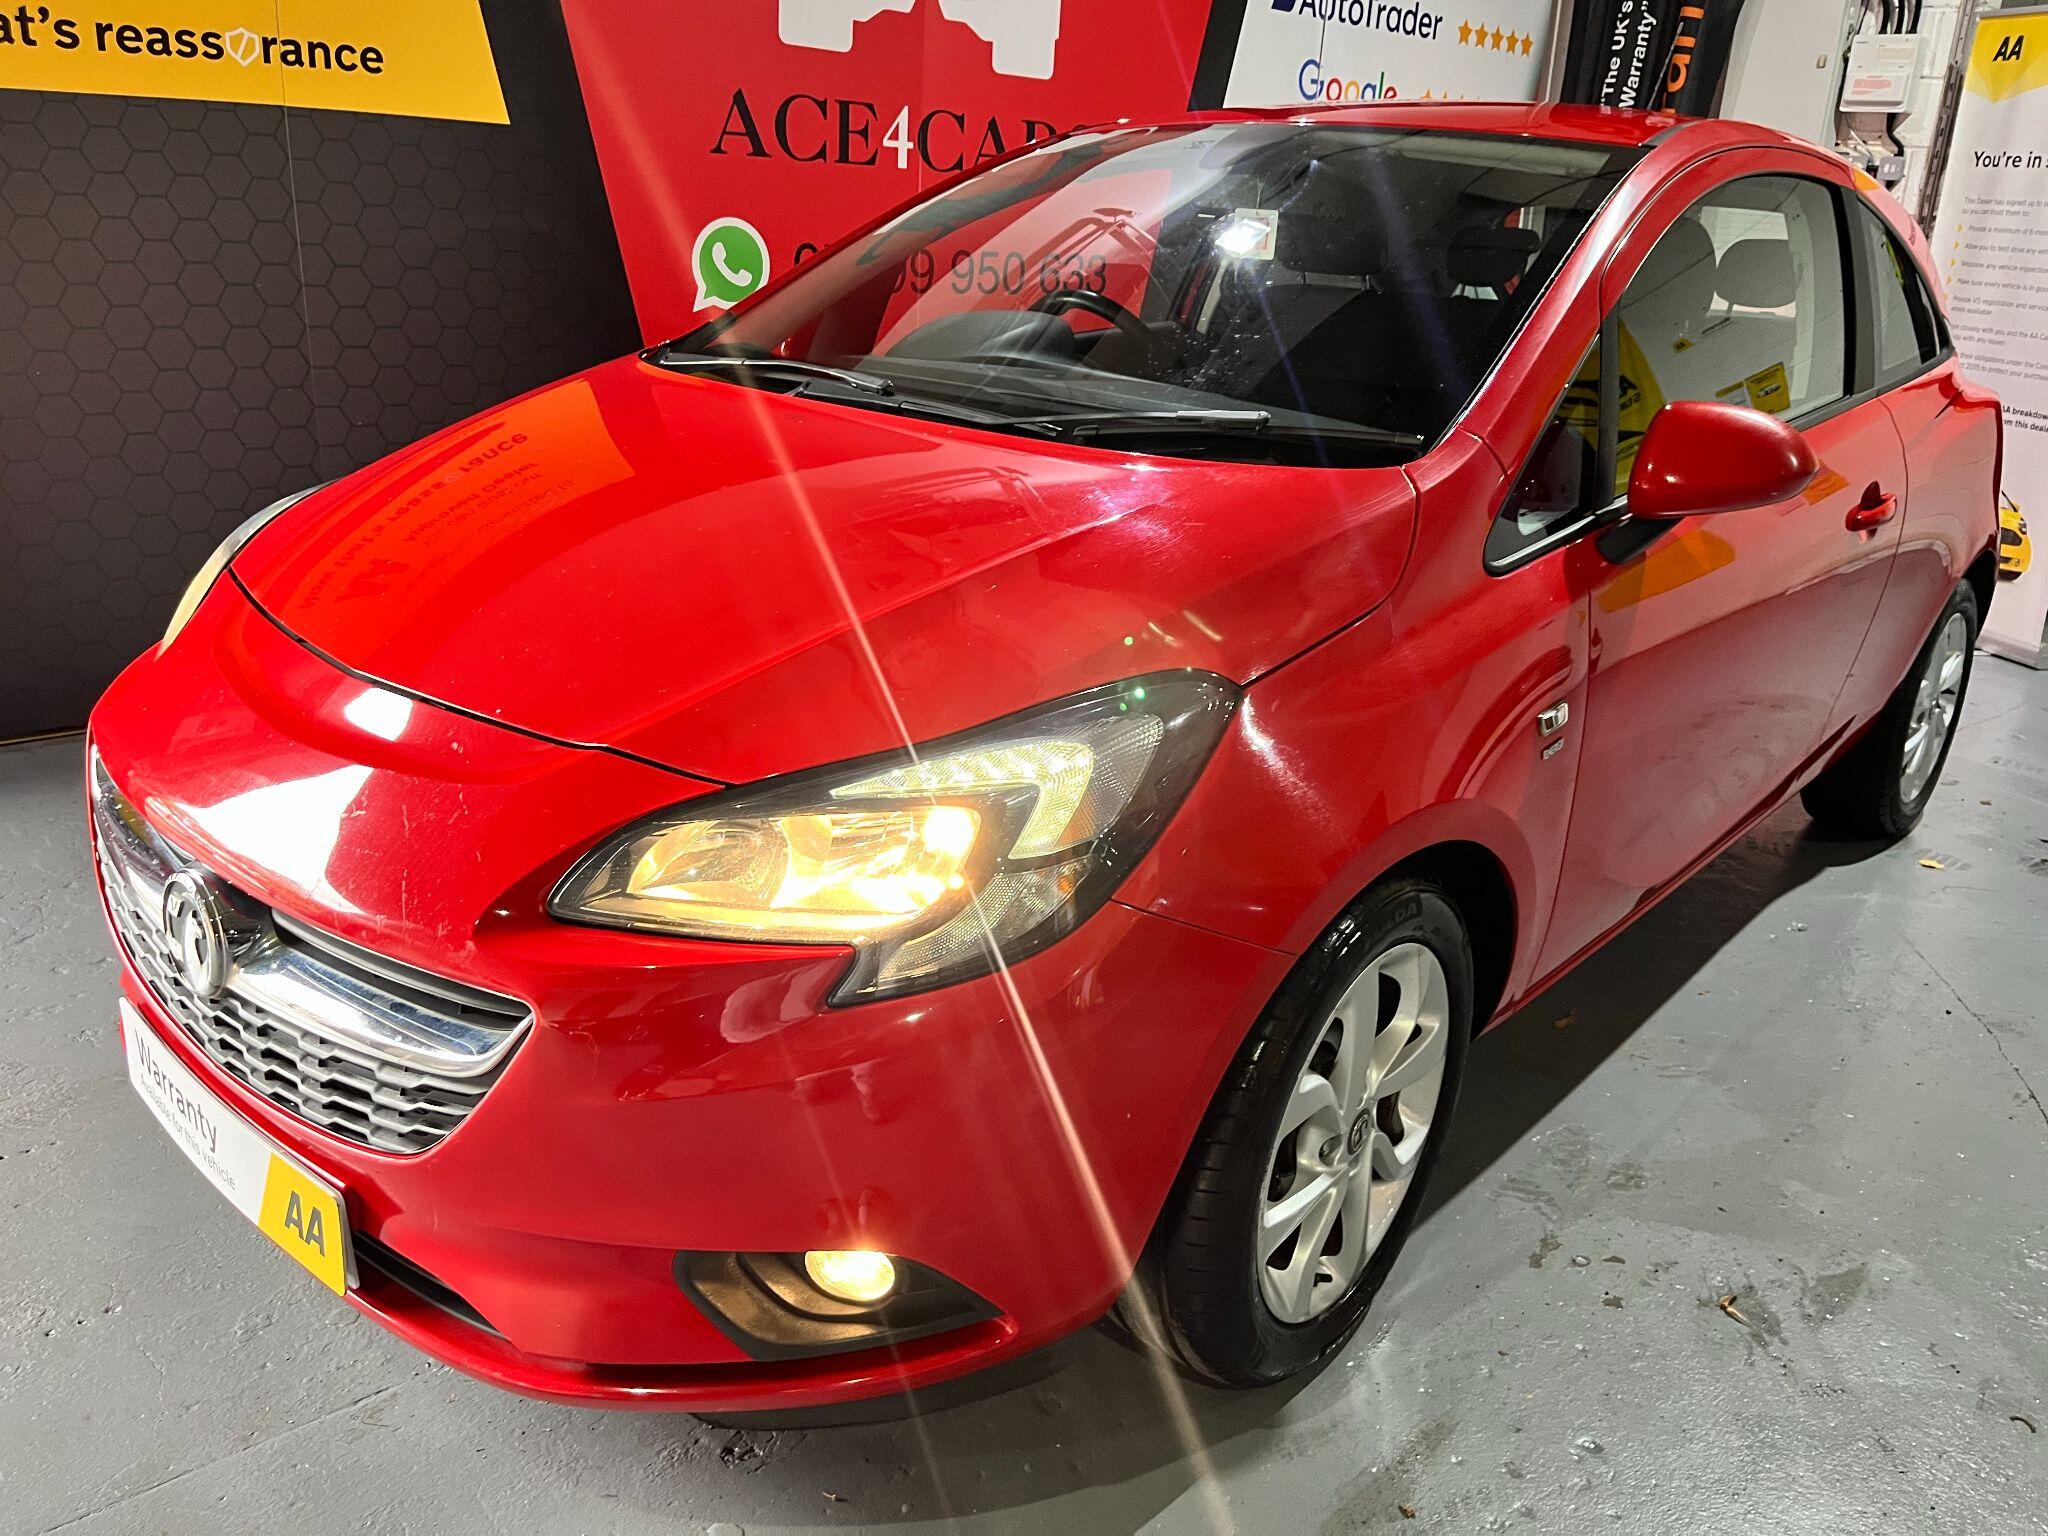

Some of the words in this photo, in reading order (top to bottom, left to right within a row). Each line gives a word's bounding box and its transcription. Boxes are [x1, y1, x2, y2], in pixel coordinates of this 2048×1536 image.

[1298, 0, 1443, 40] AutoTrader
[1611, 0, 1633, 50] UK's
[1992, 35, 2024, 61] AA
[710, 87, 1088, 173] ACE4CA
[1974, 151, 2022, 168] You're
[2026, 151, 2042, 168] in
[951, 249, 1025, 296] 950
[2015, 420, 2029, 429] this
[135, 1029, 217, 1154] Warranty
[202, 1149, 236, 1191] vehicle
[284, 1190, 325, 1257] AA
